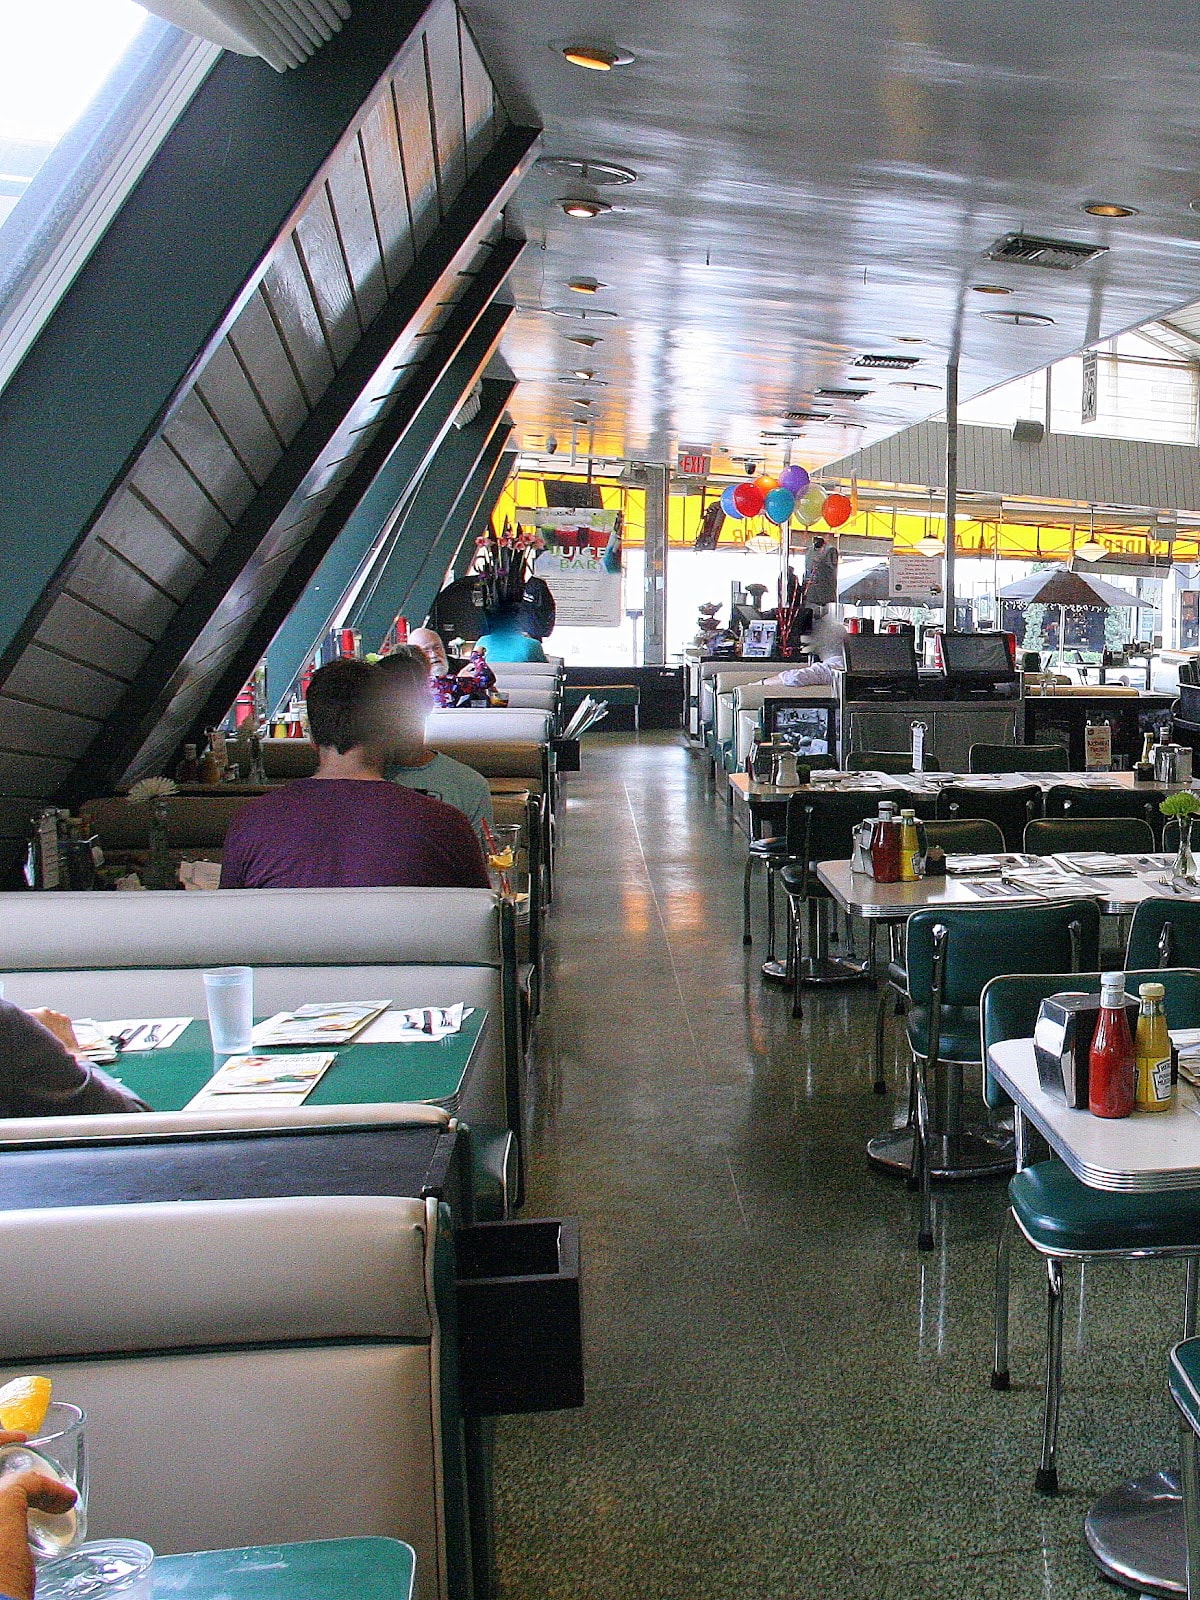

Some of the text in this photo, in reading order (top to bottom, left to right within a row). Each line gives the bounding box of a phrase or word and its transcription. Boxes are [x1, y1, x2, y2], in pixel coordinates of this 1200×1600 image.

[683, 455, 707, 474] EXIT
[550, 545, 607, 558] JUICE
[560, 559, 598, 570] BAR
